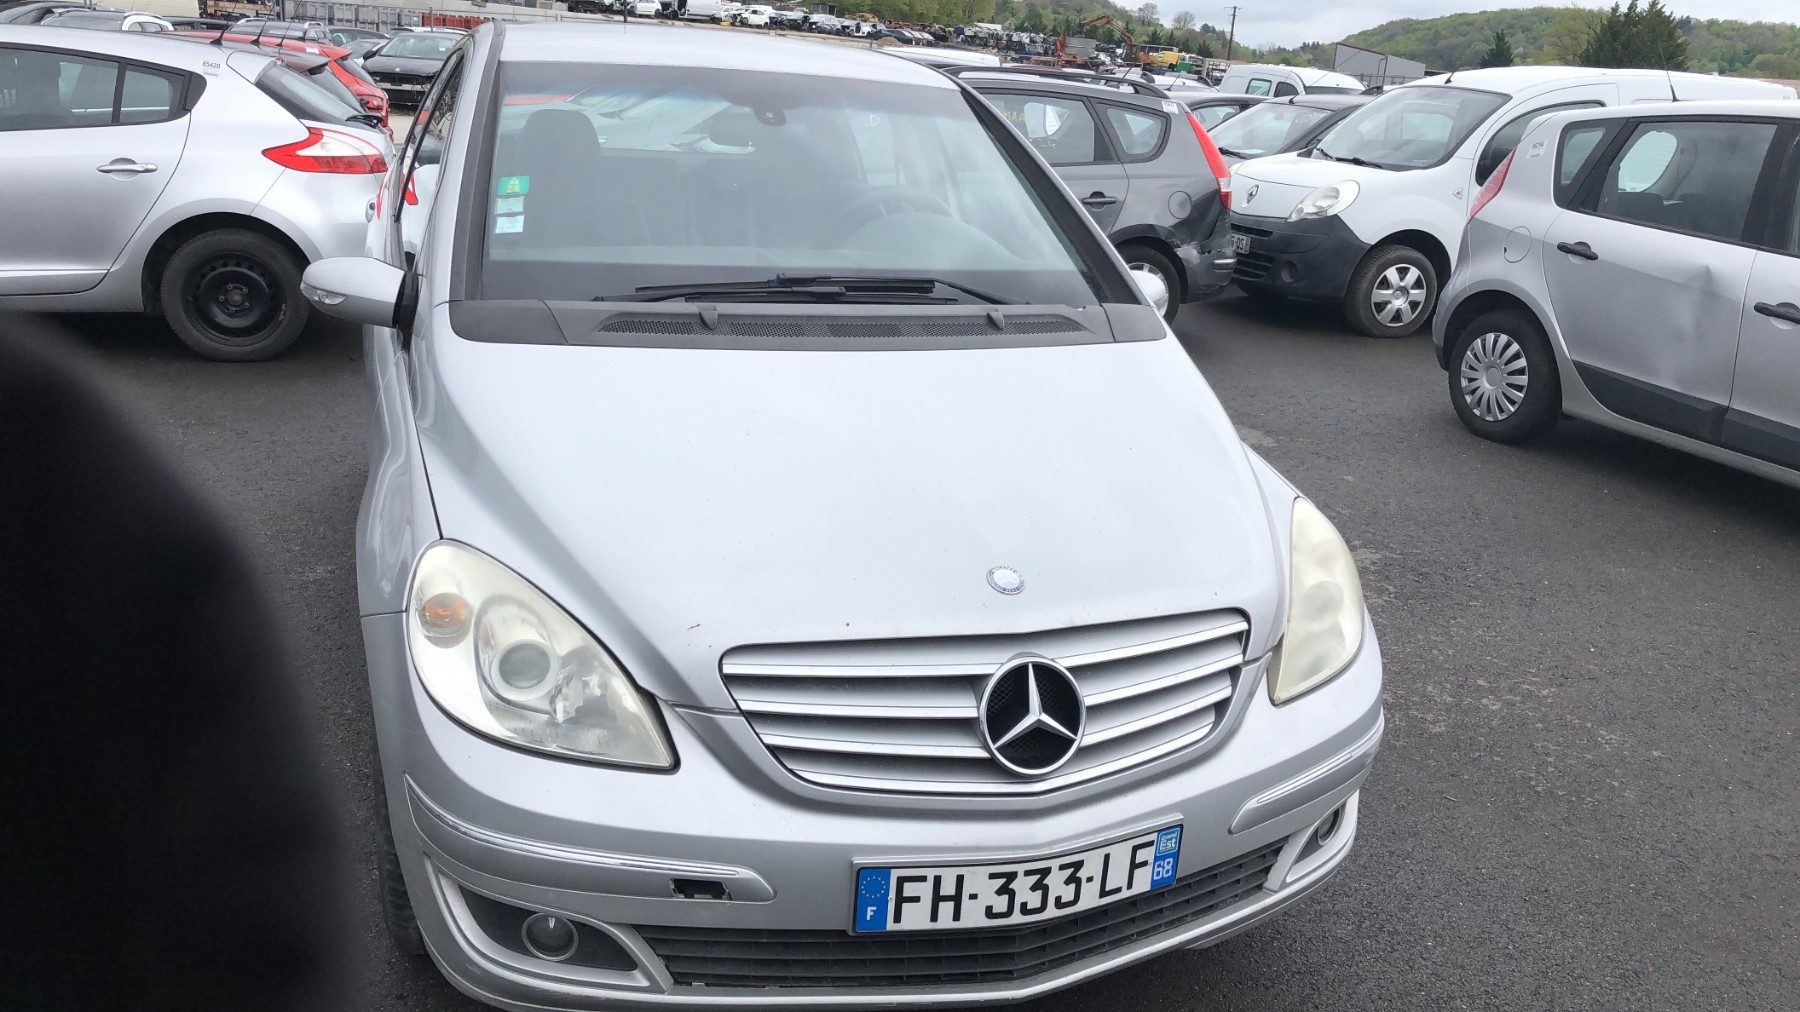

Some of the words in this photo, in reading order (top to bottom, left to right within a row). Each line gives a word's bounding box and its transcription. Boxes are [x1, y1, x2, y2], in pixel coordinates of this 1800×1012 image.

[1160, 838, 1176, 850] Est
[1153, 858, 1174, 880] 68
[893, 840, 1155, 924] FH-333-LF
[866, 907, 876, 920] F
